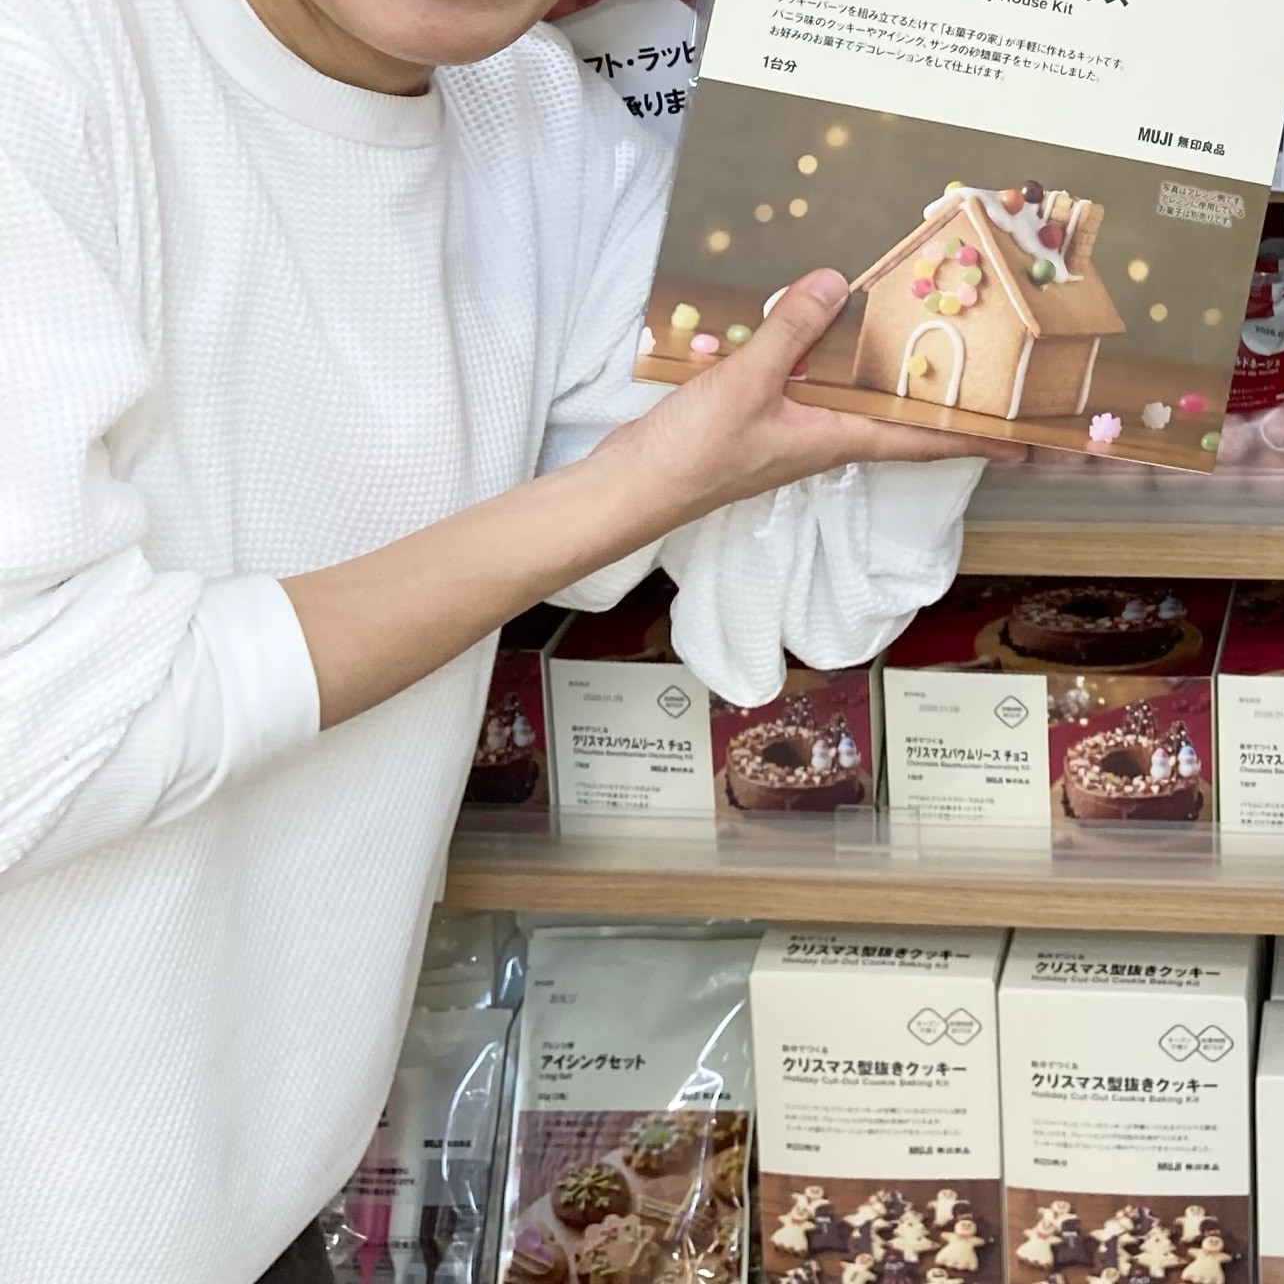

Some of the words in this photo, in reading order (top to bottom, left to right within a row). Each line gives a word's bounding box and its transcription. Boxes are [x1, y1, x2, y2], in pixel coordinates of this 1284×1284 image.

[1052, 0, 1074, 15] Kit
[762, 55, 798, 73] 1台分
[1137, 126, 1174, 147] MUJI
[1177, 135, 1226, 156] 無印良品
[1004, 750, 1028, 762] チョコ
[787, 943, 970, 960] クリスマス型抜きクッキー
[1035, 961, 1221, 978] クリスマス型抜きクッキー
[540, 1053, 646, 1070] アイシングセット
[783, 1057, 967, 1077] クリスマス型抜きクッキー
[1031, 1072, 1218, 1093] クリスマス型抜きクッキー
